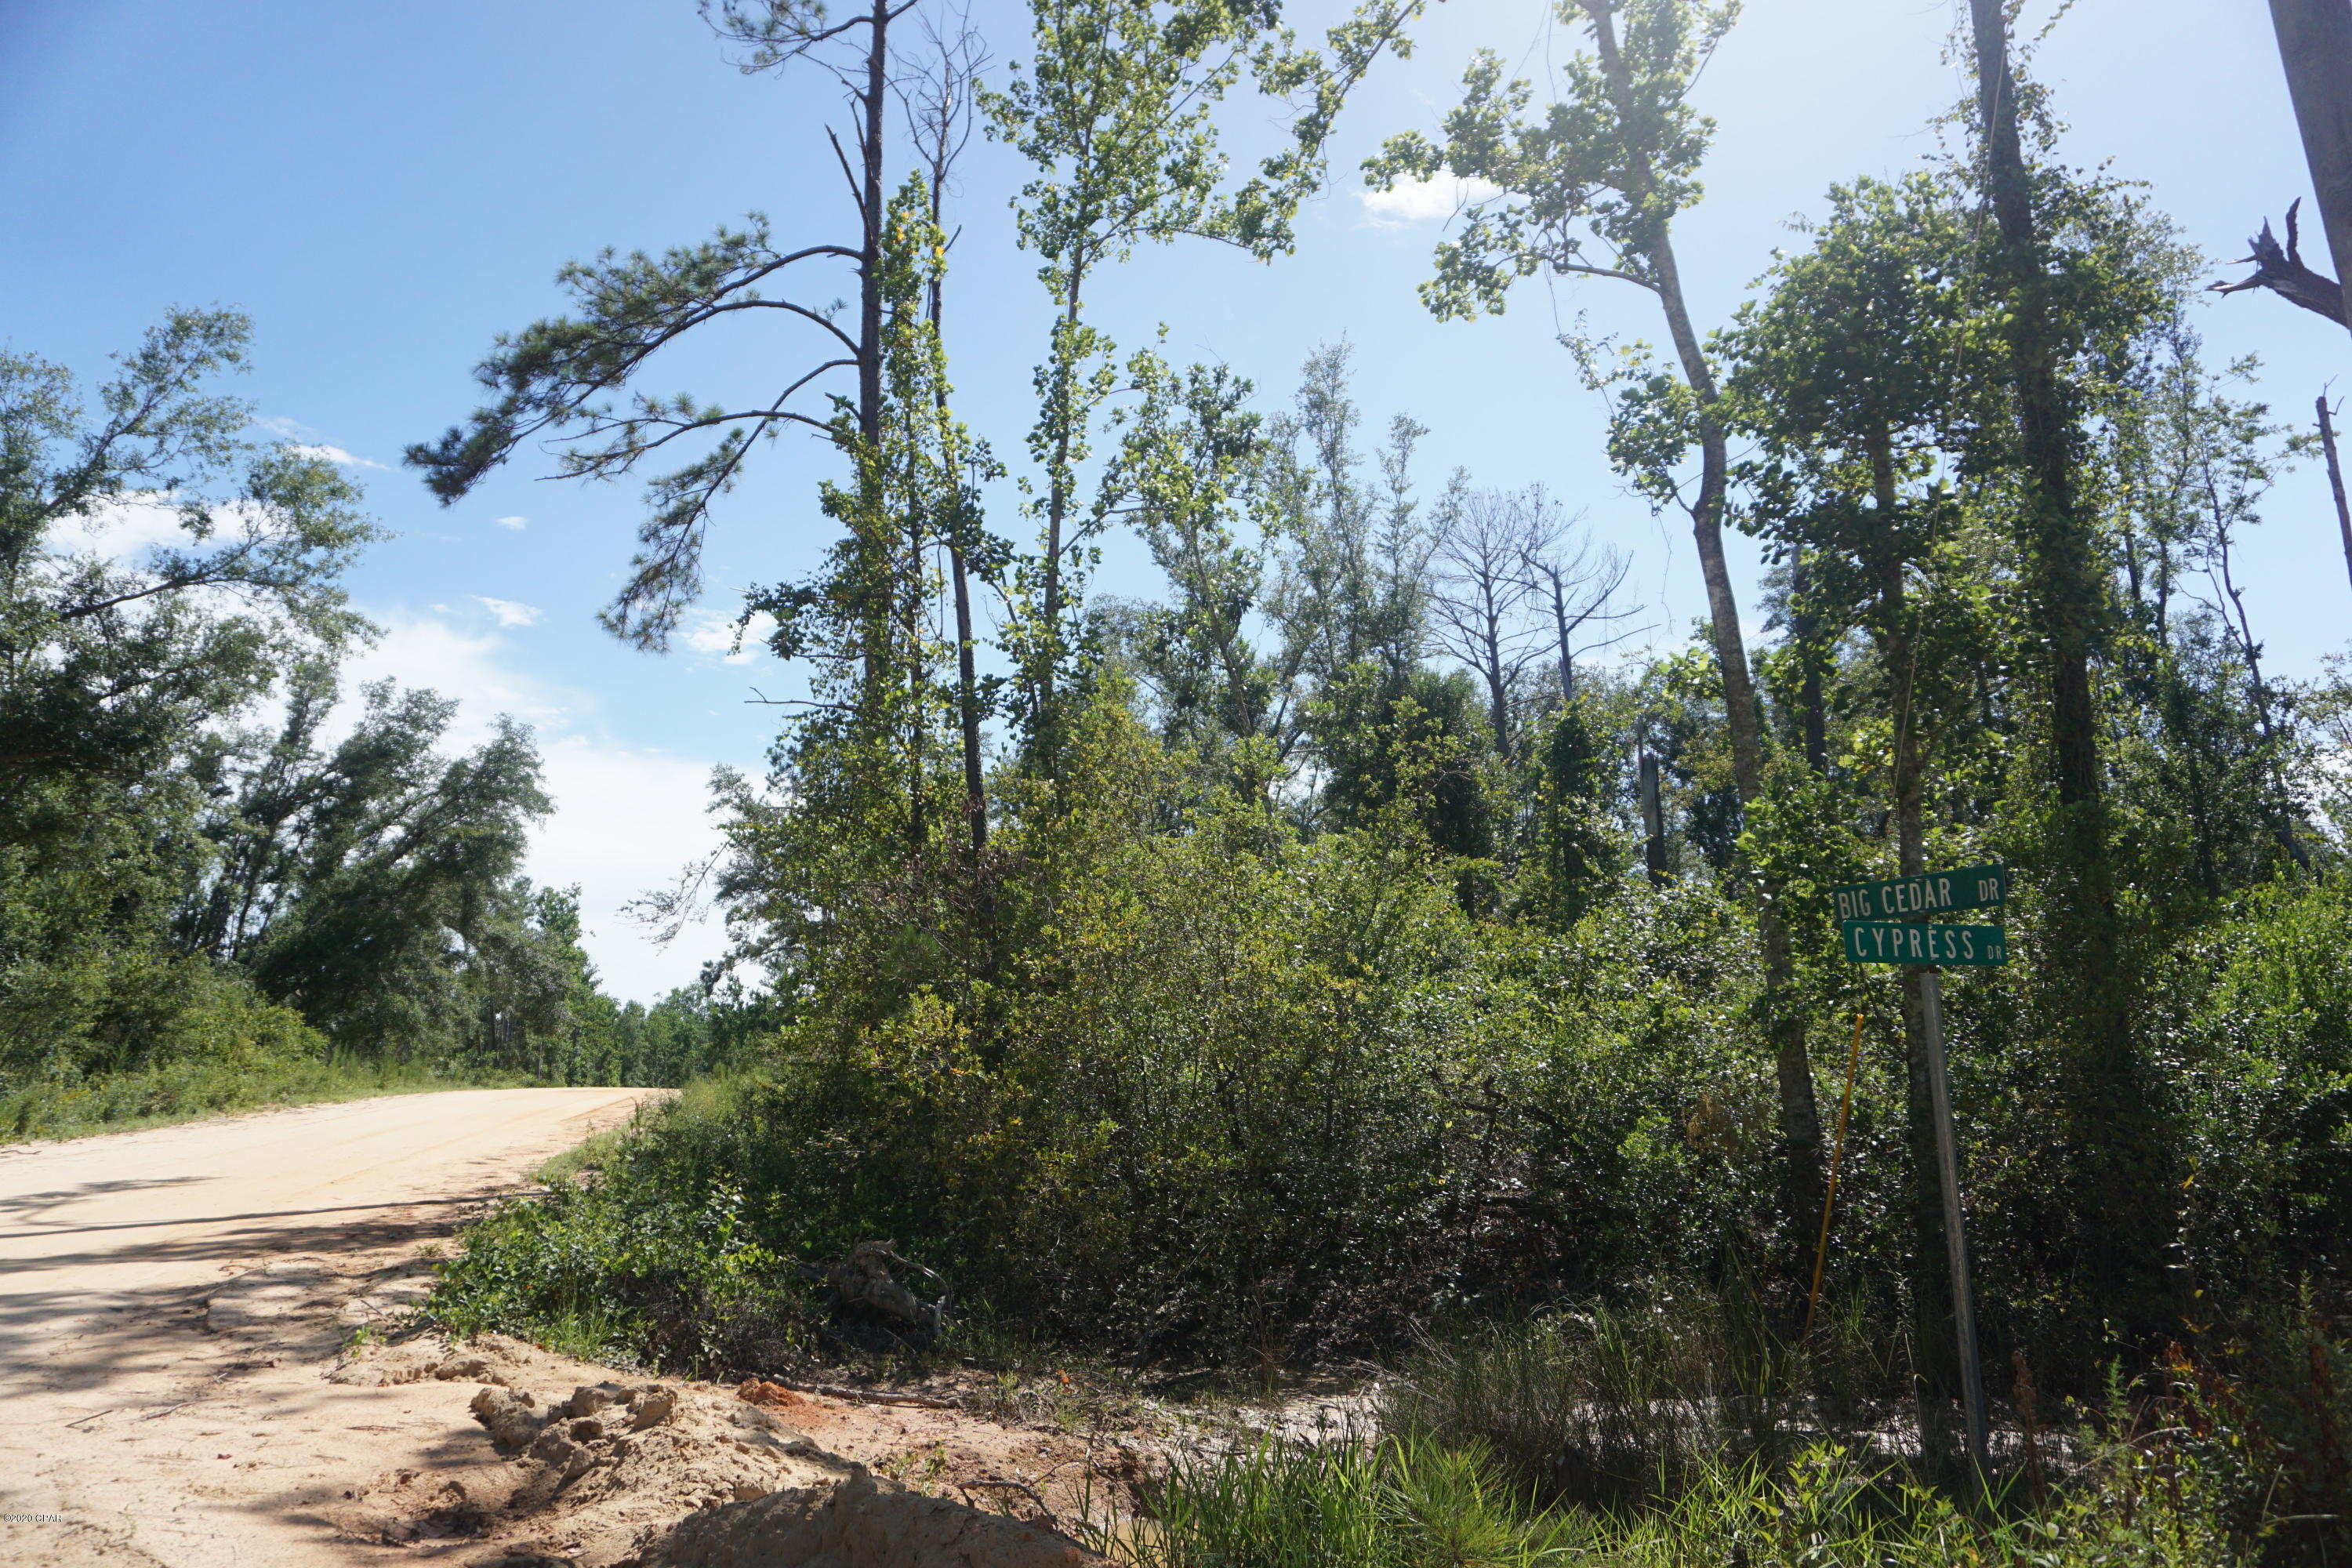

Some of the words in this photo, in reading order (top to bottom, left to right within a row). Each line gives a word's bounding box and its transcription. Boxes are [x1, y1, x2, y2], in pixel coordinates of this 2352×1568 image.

[1838, 889, 1871, 919] BIG
[1882, 878, 1952, 914] CEDAR
[1979, 877, 1999, 902] DR
[1854, 927, 1974, 959] CYPRESS
[1987, 945, 2002, 960] DR
